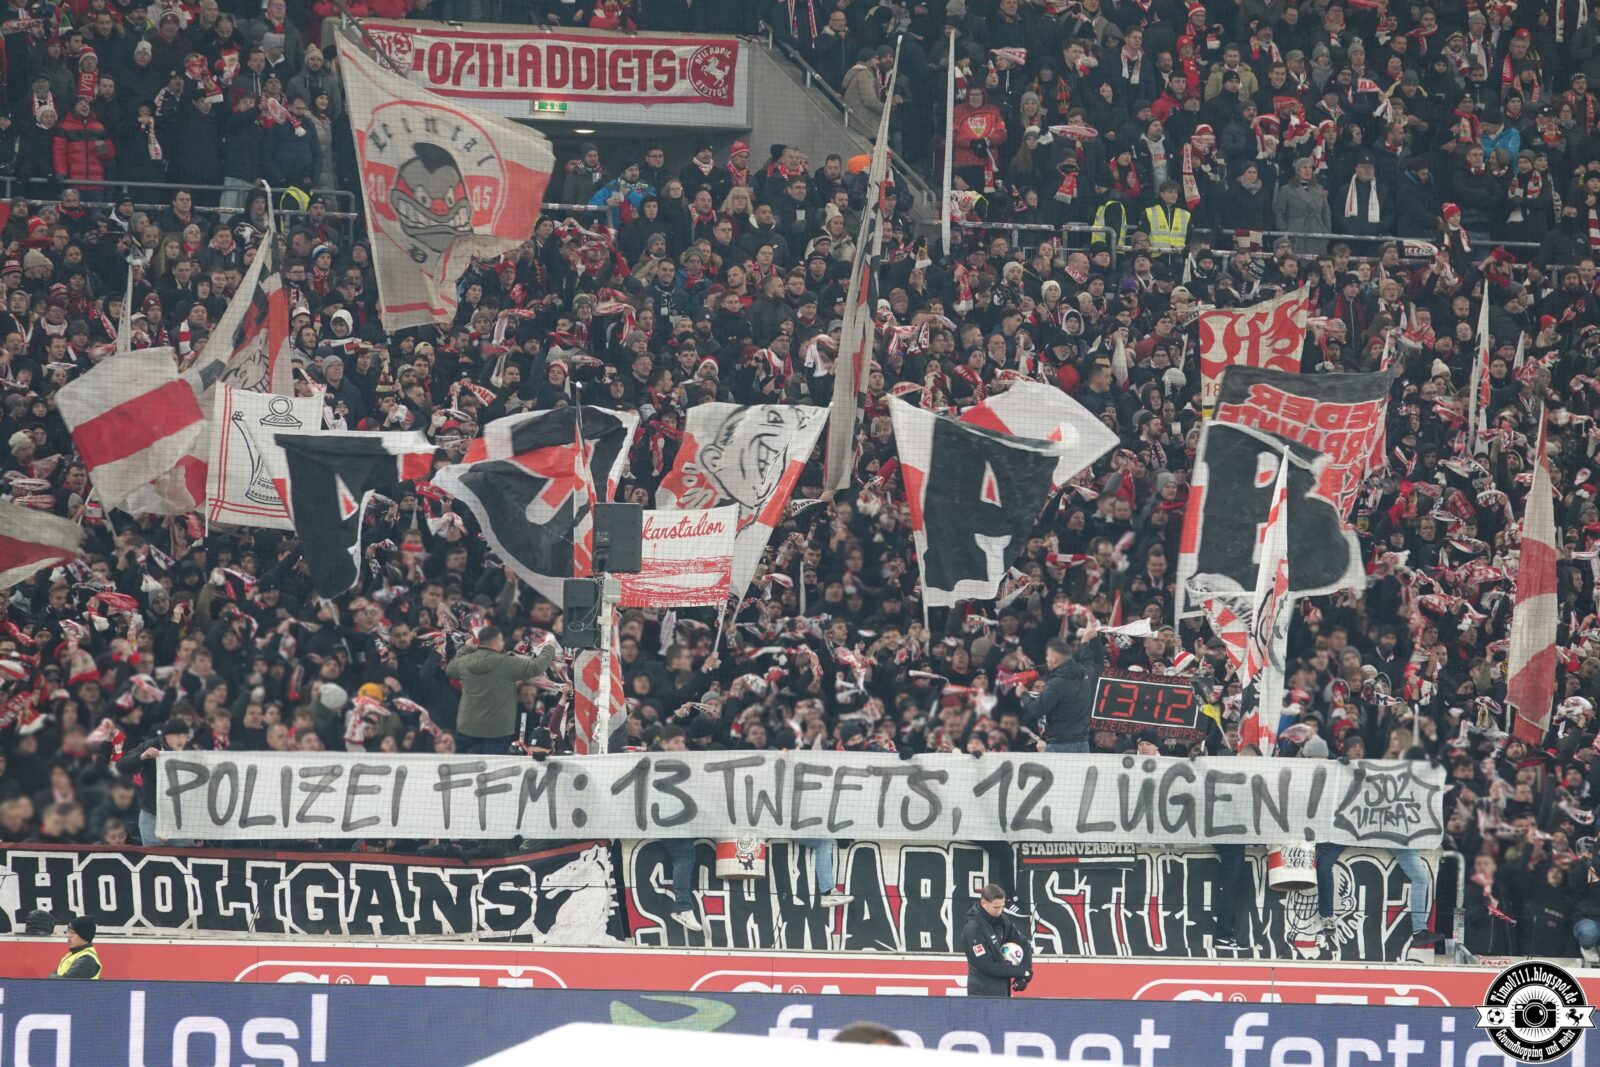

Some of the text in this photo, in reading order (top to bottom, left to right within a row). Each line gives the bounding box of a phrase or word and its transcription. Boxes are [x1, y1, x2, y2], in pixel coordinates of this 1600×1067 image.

[1098, 683, 1193, 723] 13:12
[164, 755, 1327, 841] POLIZEI FFM: 13 TWEETS, 12 LÜGEN!
[7, 850, 538, 941] HOOLIGANS
